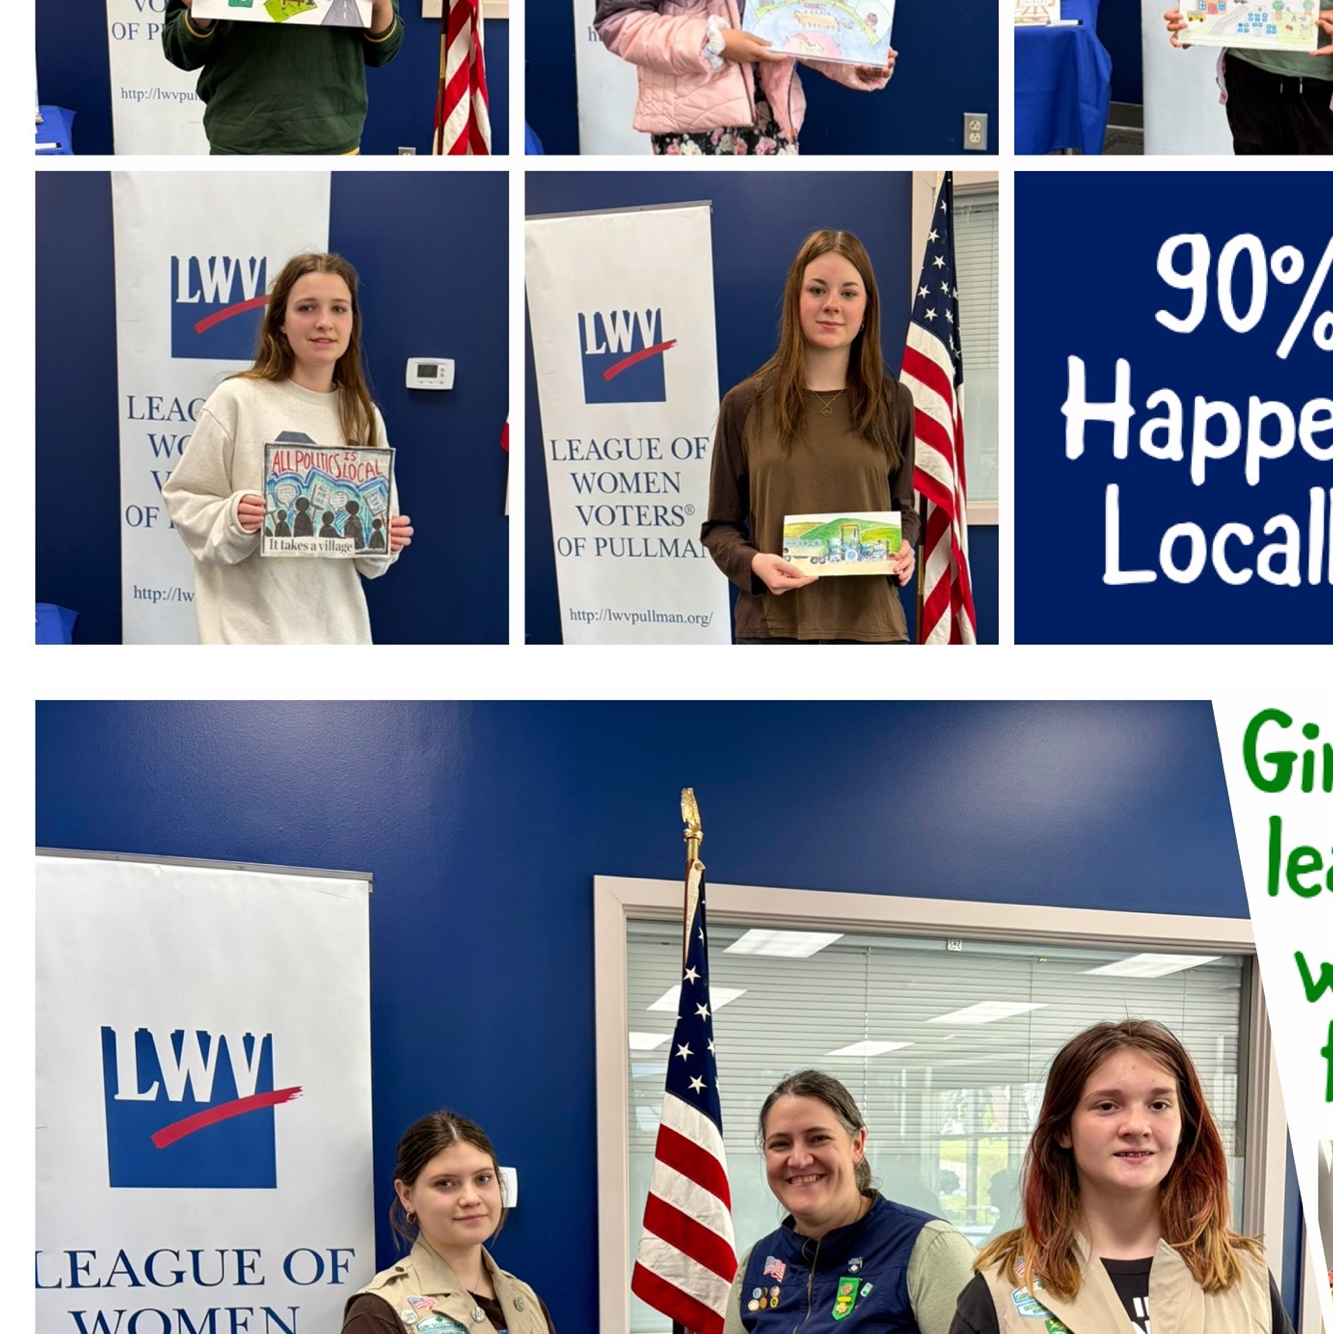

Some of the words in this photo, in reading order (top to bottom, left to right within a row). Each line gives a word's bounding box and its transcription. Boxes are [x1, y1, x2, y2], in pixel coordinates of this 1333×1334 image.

[114, 1026, 272, 1102] LWV
[34, 1249, 265, 1290] LEAGUE
[283, 1248, 356, 1286] OF
